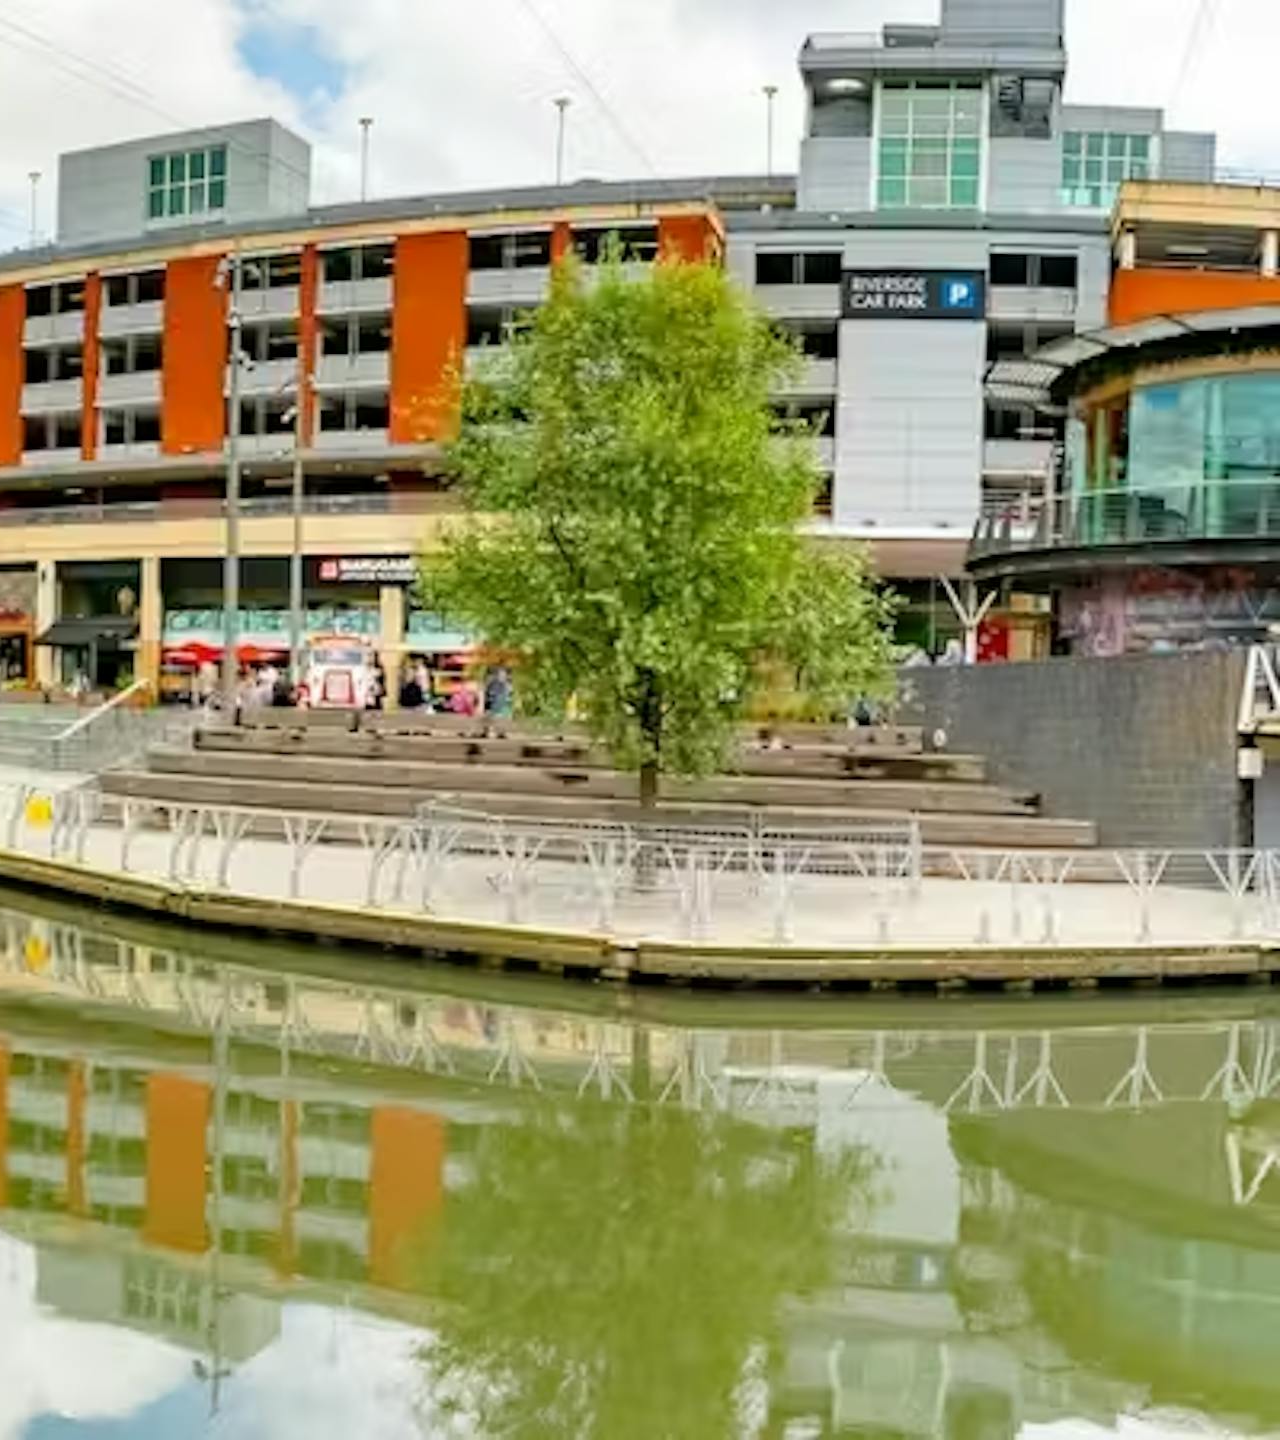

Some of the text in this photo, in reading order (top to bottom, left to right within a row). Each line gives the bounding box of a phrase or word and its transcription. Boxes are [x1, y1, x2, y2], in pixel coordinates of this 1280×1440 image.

[850, 276, 926, 292] RIVERSIDE
[850, 294, 926, 308] CAR PARK
[949, 282, 970, 305] P
